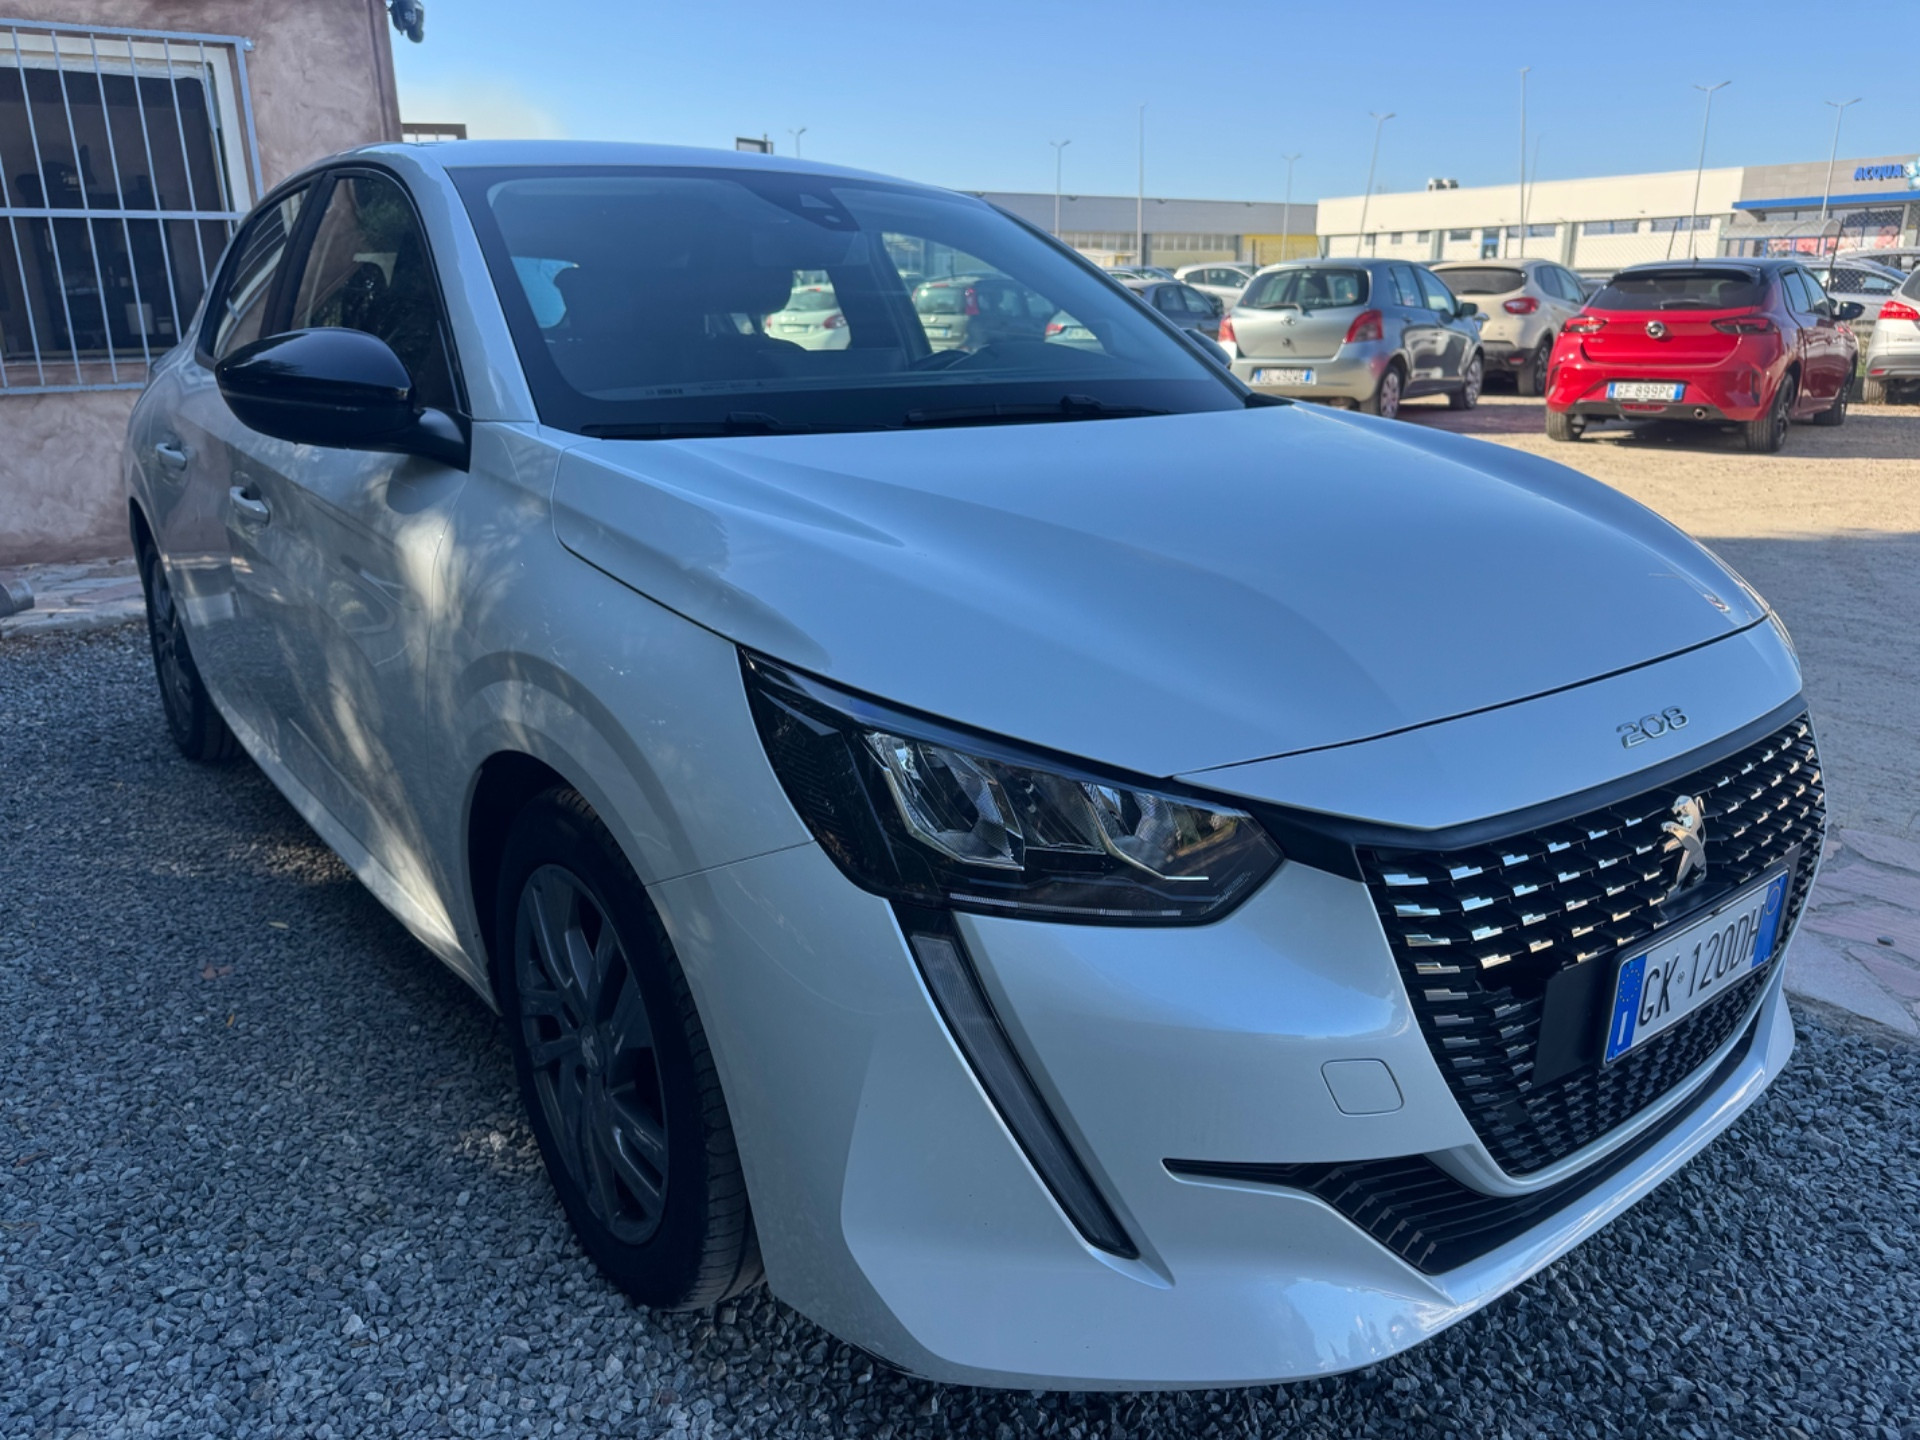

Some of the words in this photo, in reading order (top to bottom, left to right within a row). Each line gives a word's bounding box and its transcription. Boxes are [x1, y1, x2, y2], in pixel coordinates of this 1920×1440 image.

[1854, 164, 1903, 181] ACQUA
[1616, 705, 1690, 750] 208
[1638, 953, 1681, 1027] GK
[1688, 903, 1765, 998] 120DH
